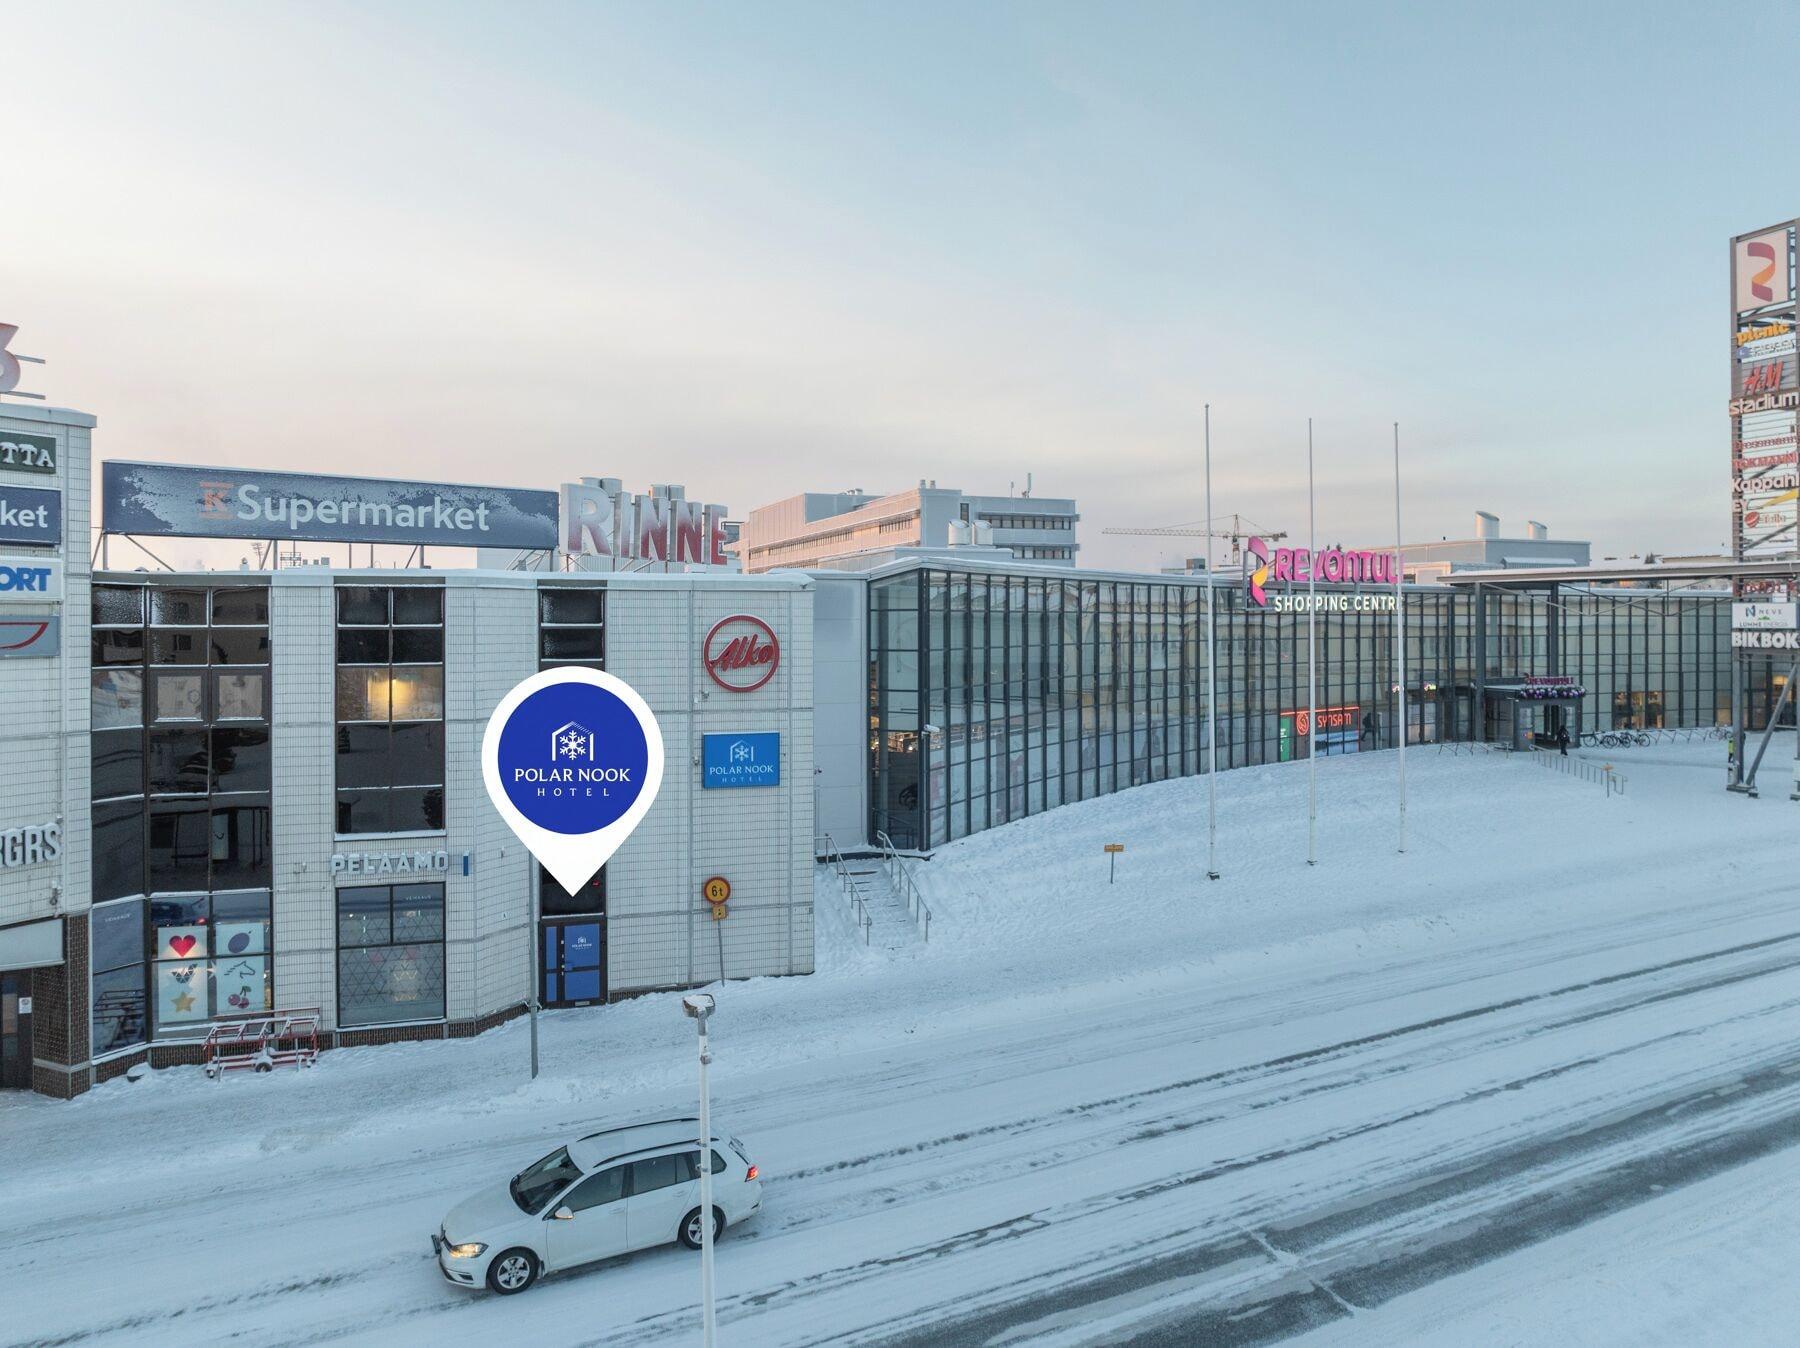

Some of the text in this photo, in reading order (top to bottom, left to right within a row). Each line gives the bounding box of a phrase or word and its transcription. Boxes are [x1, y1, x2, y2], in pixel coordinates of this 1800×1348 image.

[1729, 391, 1799, 416] stadium
[237, 484, 490, 532] Supermarket
[560, 483, 728, 566] RINNE
[1275, 596, 1348, 612] SHOPPING
[709, 633, 775, 672] Alko
[710, 765, 774, 775] POLAR NOOK
[0, 822, 62, 868] GRS
